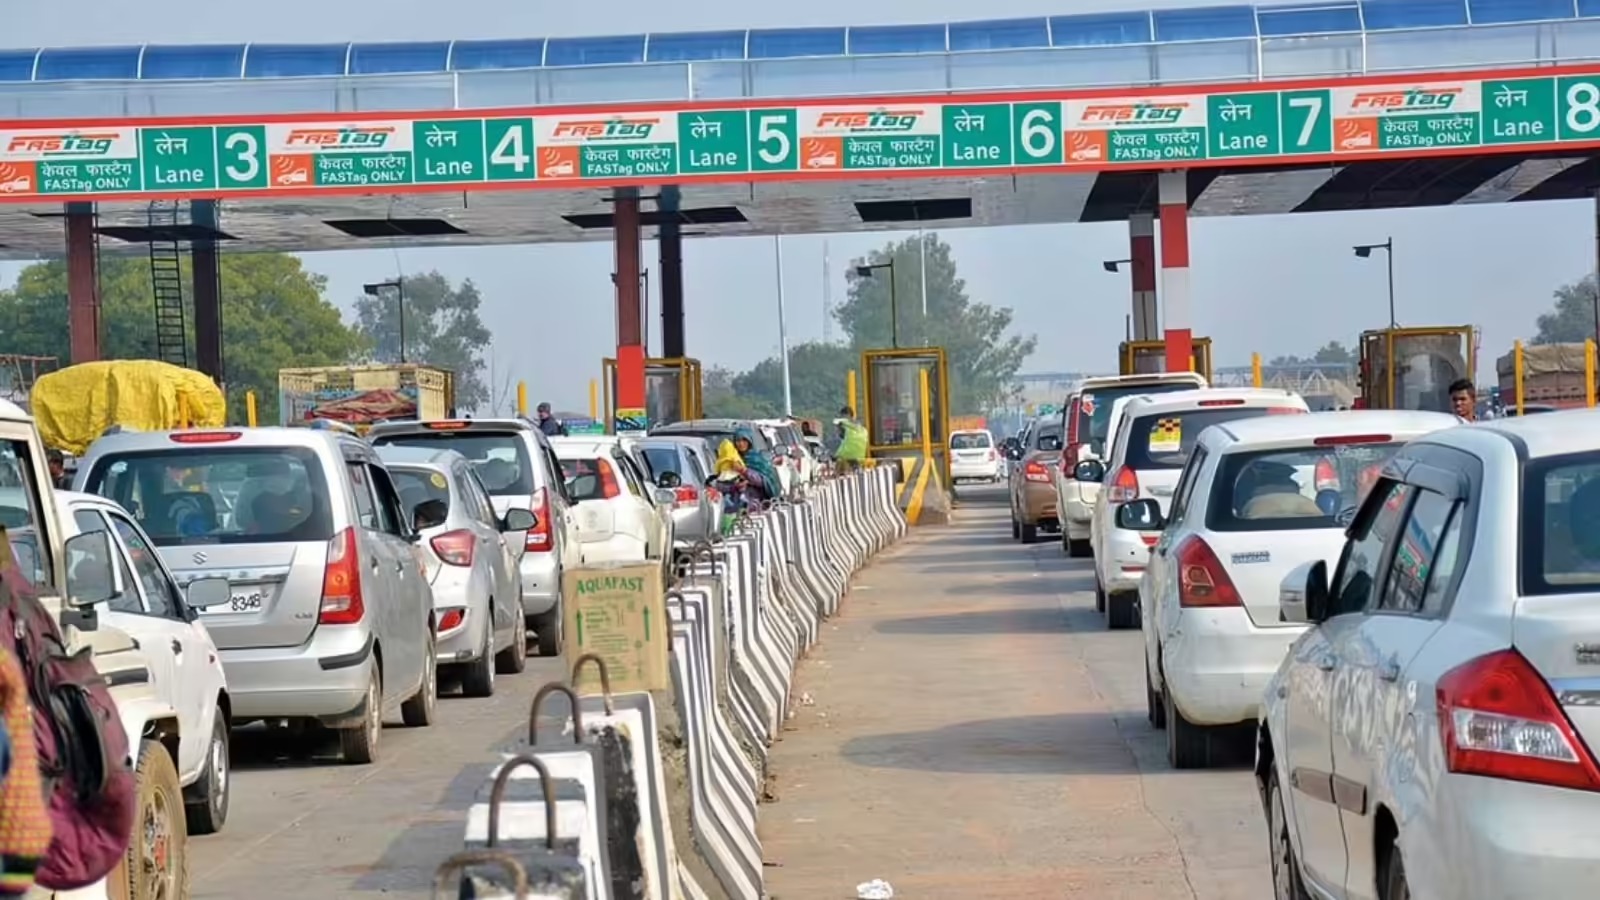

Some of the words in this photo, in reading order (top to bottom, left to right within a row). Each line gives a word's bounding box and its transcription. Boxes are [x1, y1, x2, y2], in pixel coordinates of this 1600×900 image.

[1494, 85, 1528, 108] लेन
[1218, 99, 1252, 122] लेन
[1566, 82, 1600, 132] 8
[690, 116, 722, 139] लेन
[953, 109, 985, 132] लेन
[1288, 98, 1322, 146] 7
[1384, 118, 1418, 134] केवल
[1494, 118, 1543, 137] Lane
[425, 124, 458, 147] लेन
[758, 115, 790, 164] 5
[1021, 109, 1055, 158] 6
[1112, 131, 1147, 147] केवल
[1219, 133, 1268, 150] Lane
[1386, 134, 1433, 147] FASTag
[1436, 132, 1472, 144] ONLY
[154, 132, 188, 155] लेन
[491, 125, 530, 173] 4
[848, 138, 883, 153] केवल
[953, 143, 1000, 160] Lane
[225, 132, 259, 181] 3
[584, 147, 619, 163] केवल
[691, 149, 737, 167] Lane
[850, 155, 896, 167] FASTag
[899, 154, 933, 165] ONLY
[1114, 148, 1161, 160] FASTag
[1164, 146, 1199, 158] ONLY
[41, 162, 77, 178] केवल
[318, 155, 353, 170] केवल
[426, 158, 473, 176] Lane
[587, 163, 633, 176] FASTag
[636, 161, 670, 174] ONLY
[155, 166, 204, 184] Lane
[321, 171, 368, 184] FASTag
[371, 170, 405, 182] ONLY
[44, 179, 92, 192] FASTag
[96, 177, 131, 189] ONLY
[577, 576, 644, 594] AQUAFAST
[232, 593, 260, 611] 8348
